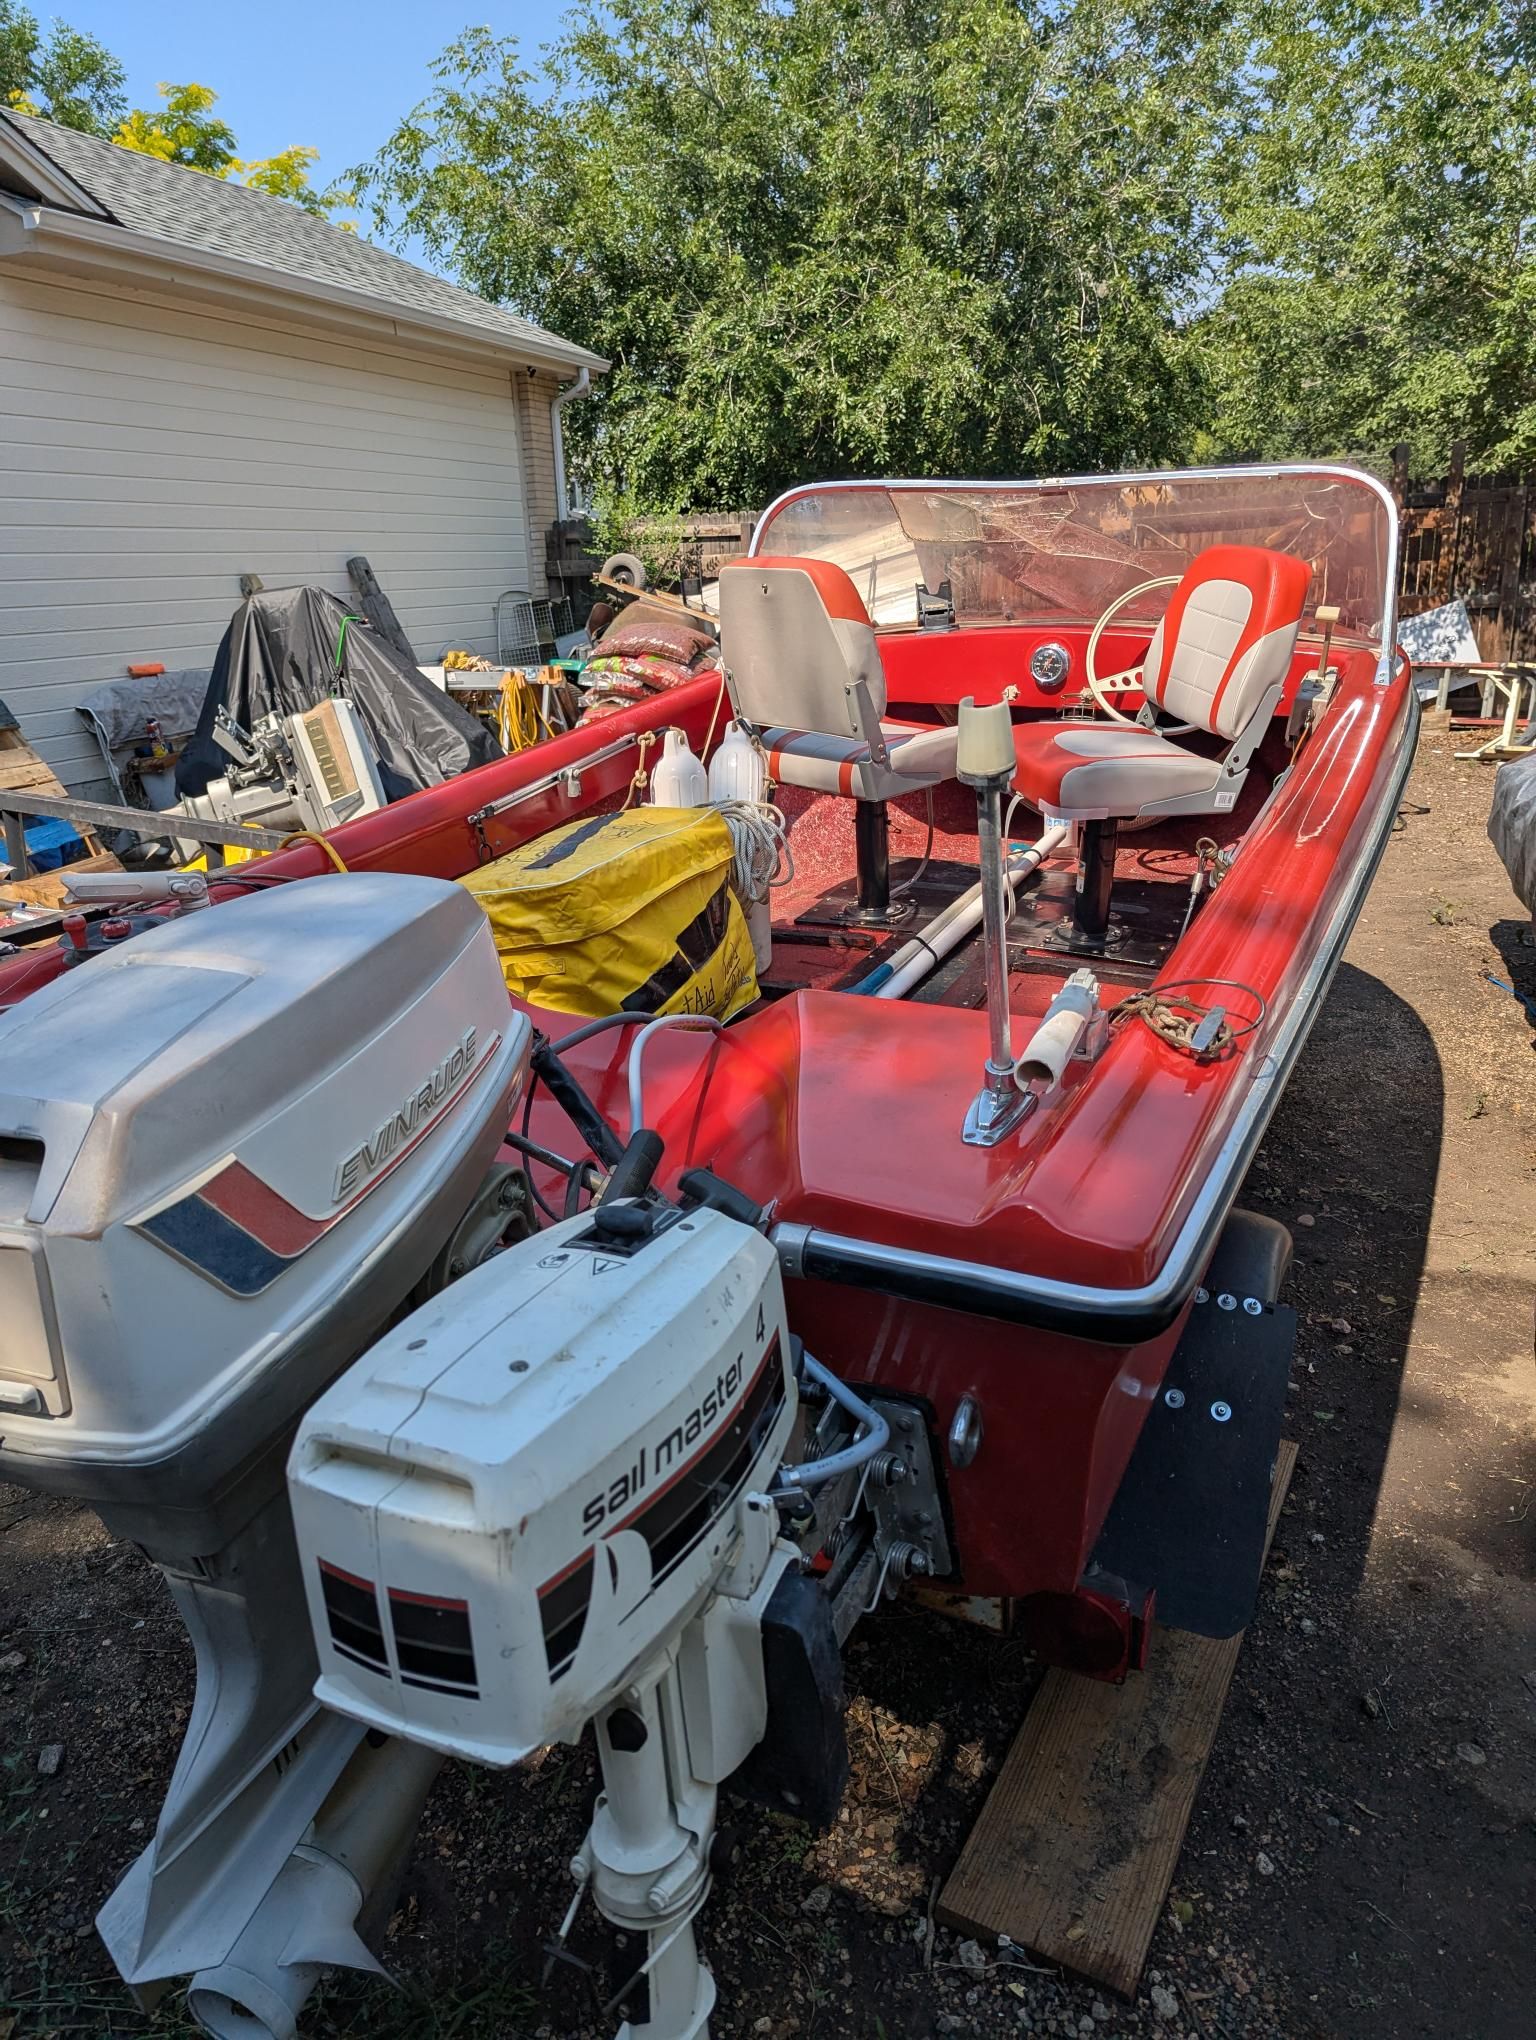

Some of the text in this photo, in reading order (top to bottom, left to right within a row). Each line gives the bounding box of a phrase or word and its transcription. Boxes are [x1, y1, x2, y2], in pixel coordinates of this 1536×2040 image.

[308, 724, 345, 799] EVIE
[694, 977, 716, 1014] Aid
[332, 1025, 476, 1203] EVINRUDE
[755, 1301, 765, 1343] 4
[583, 1352, 743, 1536] sail master
